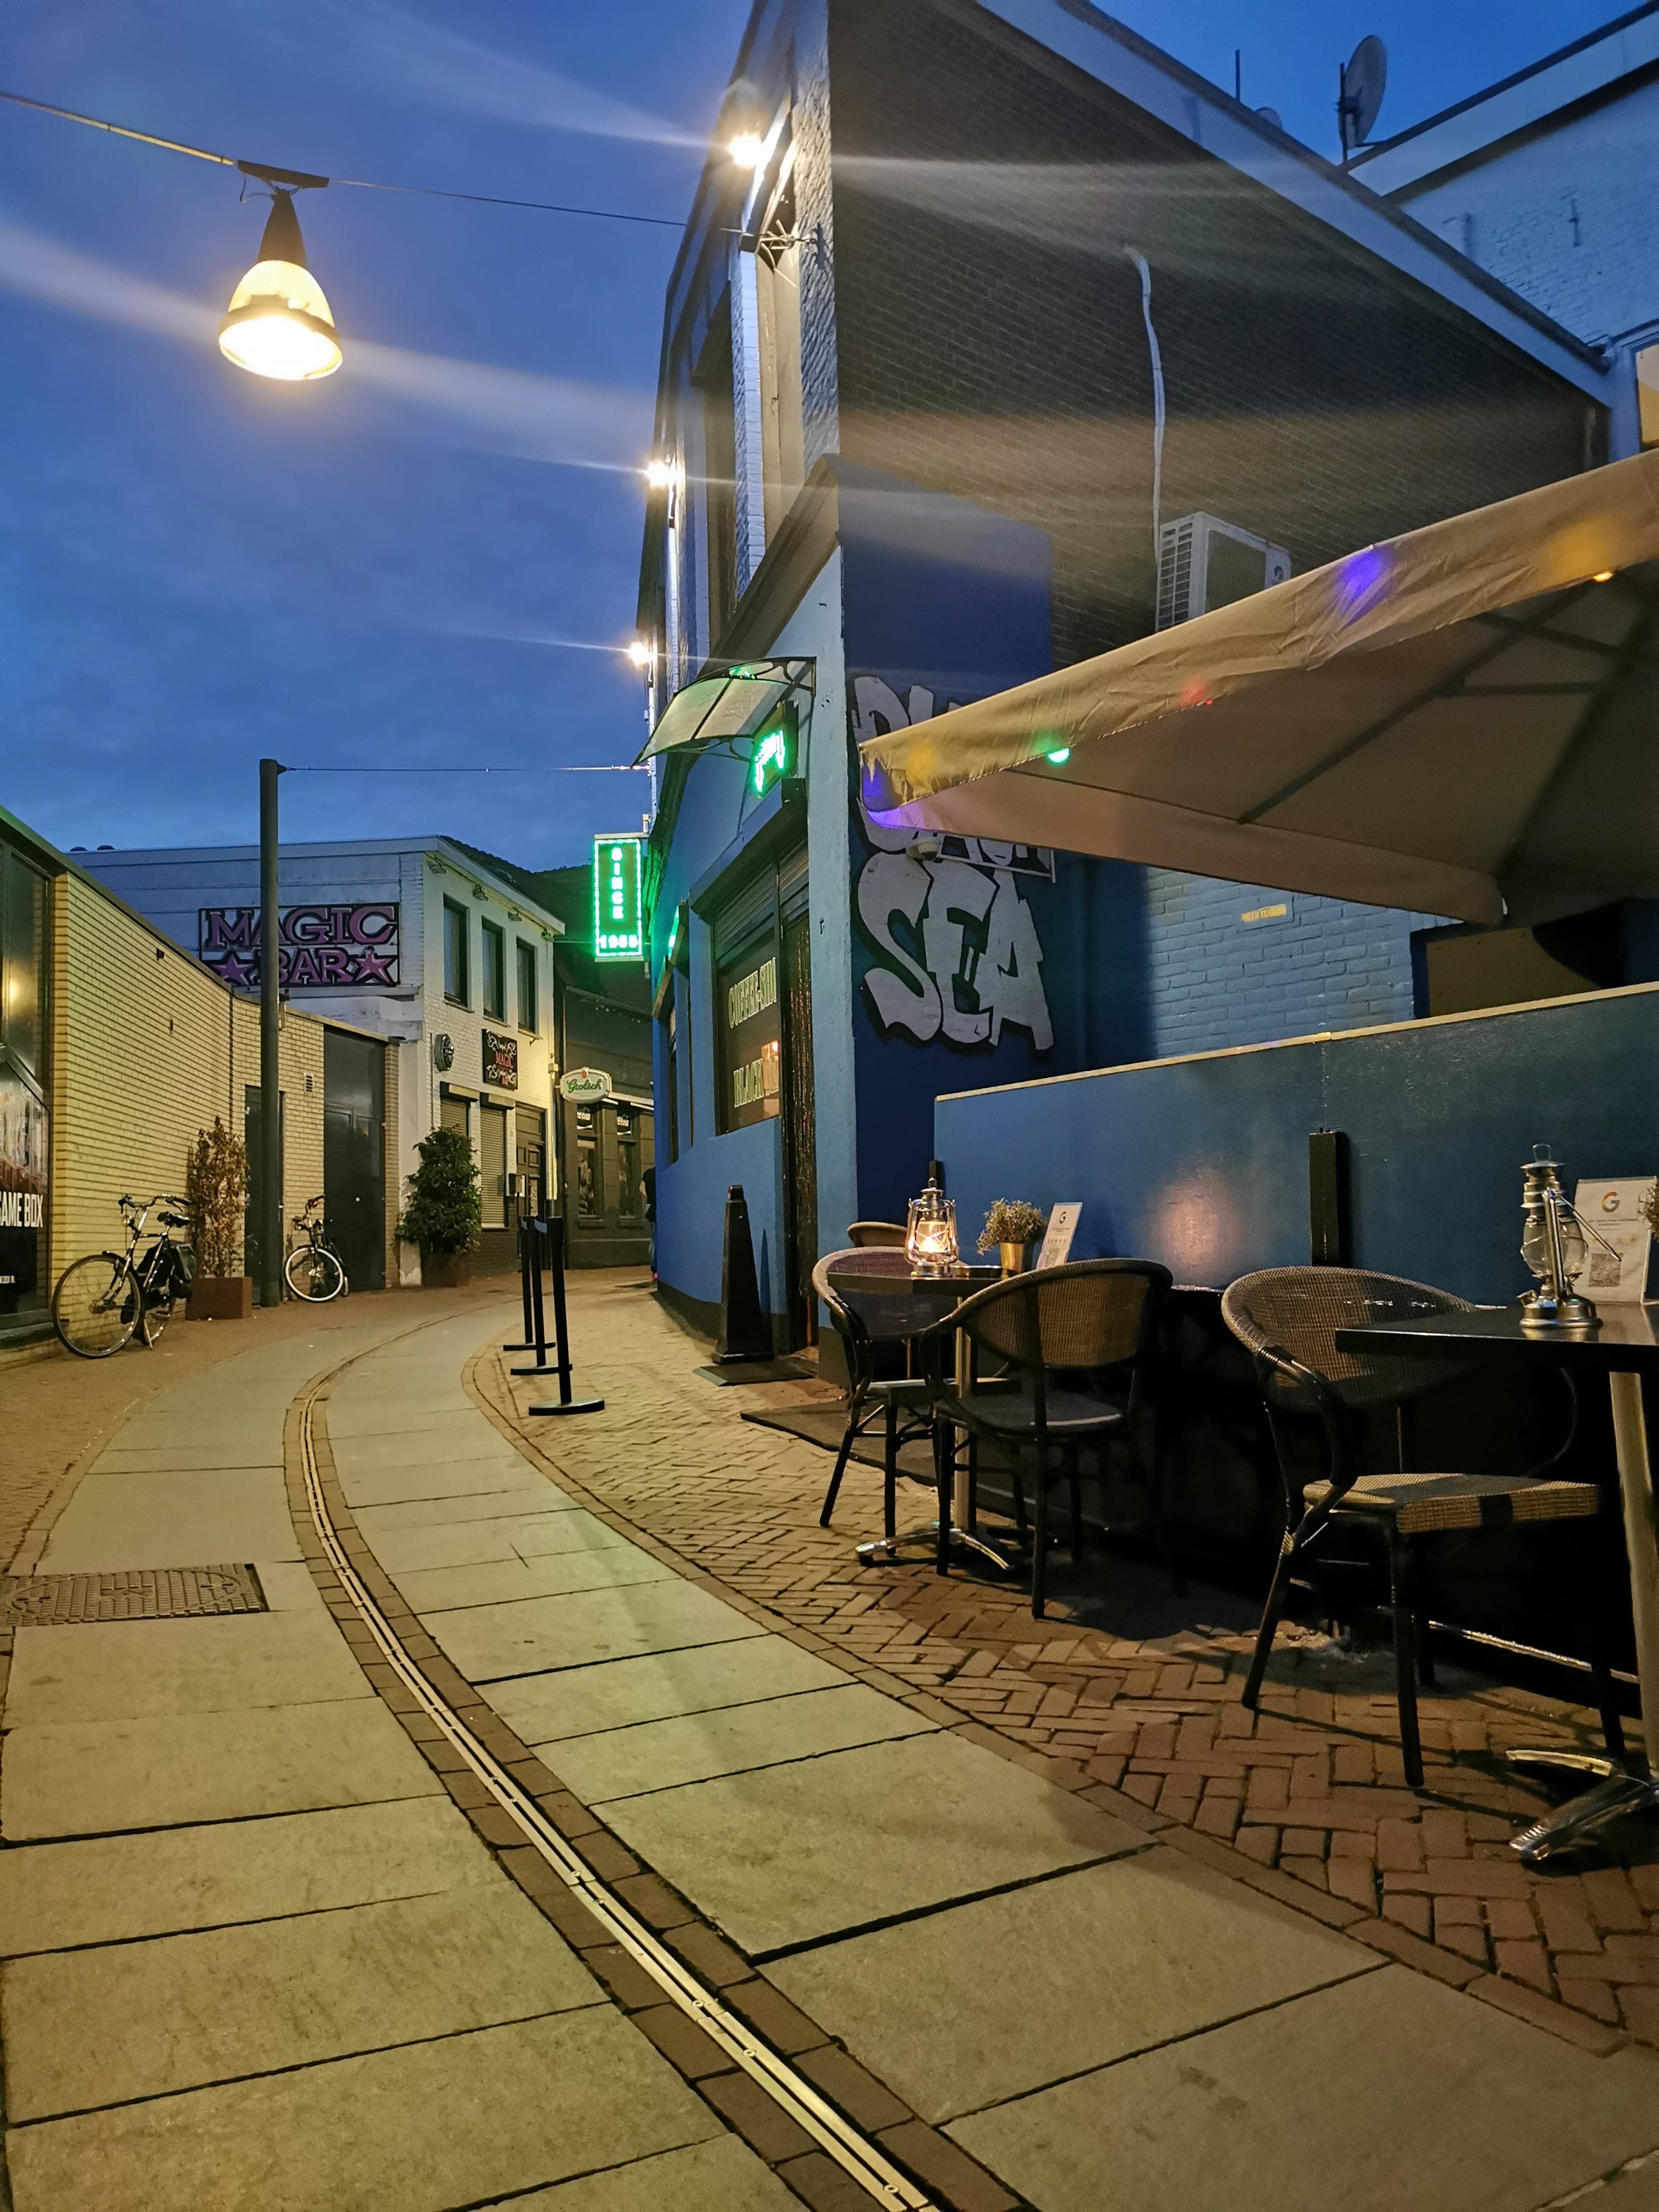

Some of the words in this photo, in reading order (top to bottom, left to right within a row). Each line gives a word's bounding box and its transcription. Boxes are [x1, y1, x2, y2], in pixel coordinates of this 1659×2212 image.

[611, 847, 624, 919] SINCE
[857, 851, 1054, 1051] SEA
[566, 1079, 602, 1093] Grolsch
[0, 1191, 22, 1227] AME
[24, 1193, 44, 1228] BOX
